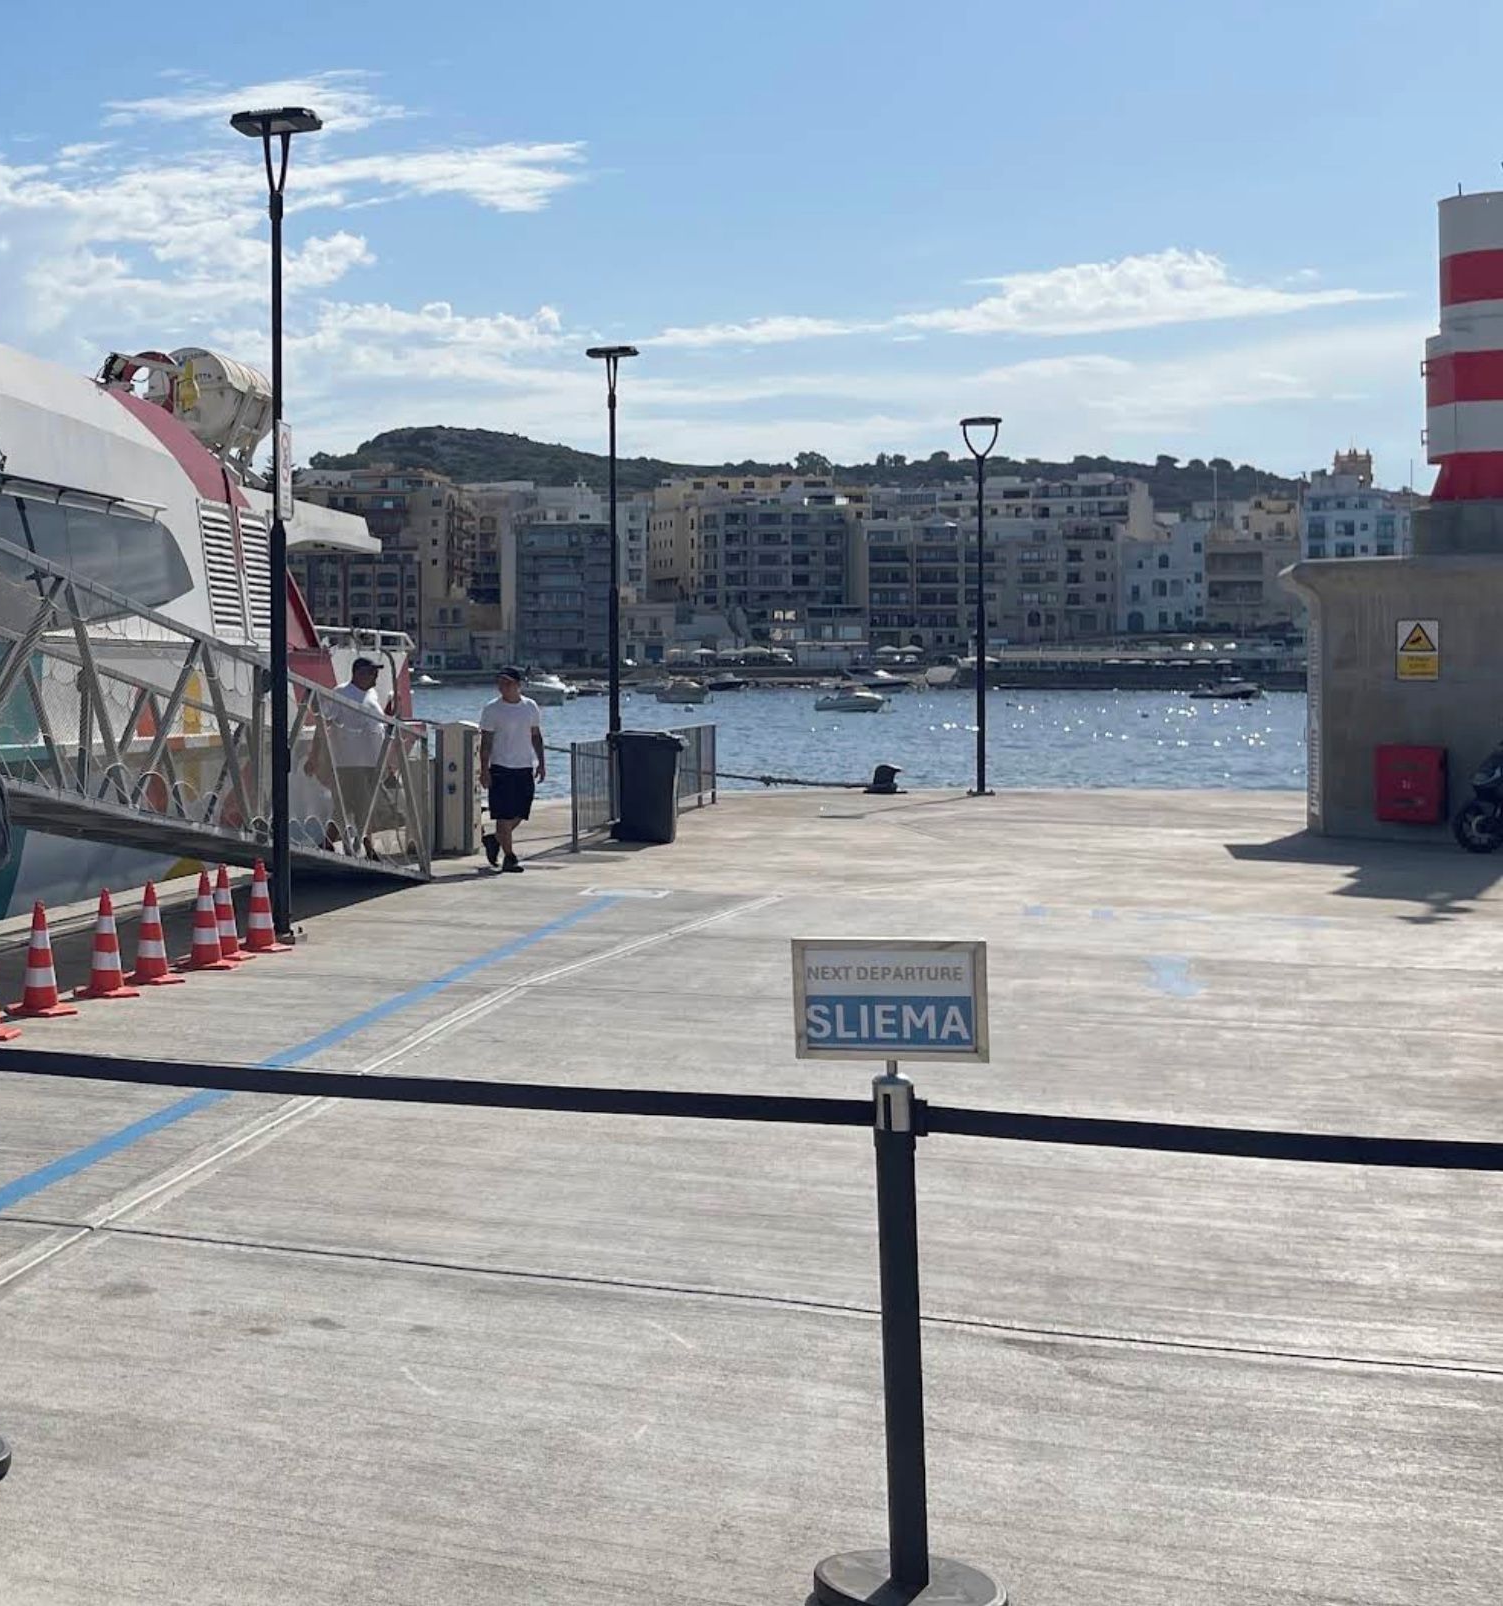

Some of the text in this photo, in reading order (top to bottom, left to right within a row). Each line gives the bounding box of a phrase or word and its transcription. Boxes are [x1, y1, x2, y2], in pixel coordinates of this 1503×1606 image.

[807, 966, 963, 981] NEXT DEPARTURE
[807, 1004, 970, 1040] SLIEMA
